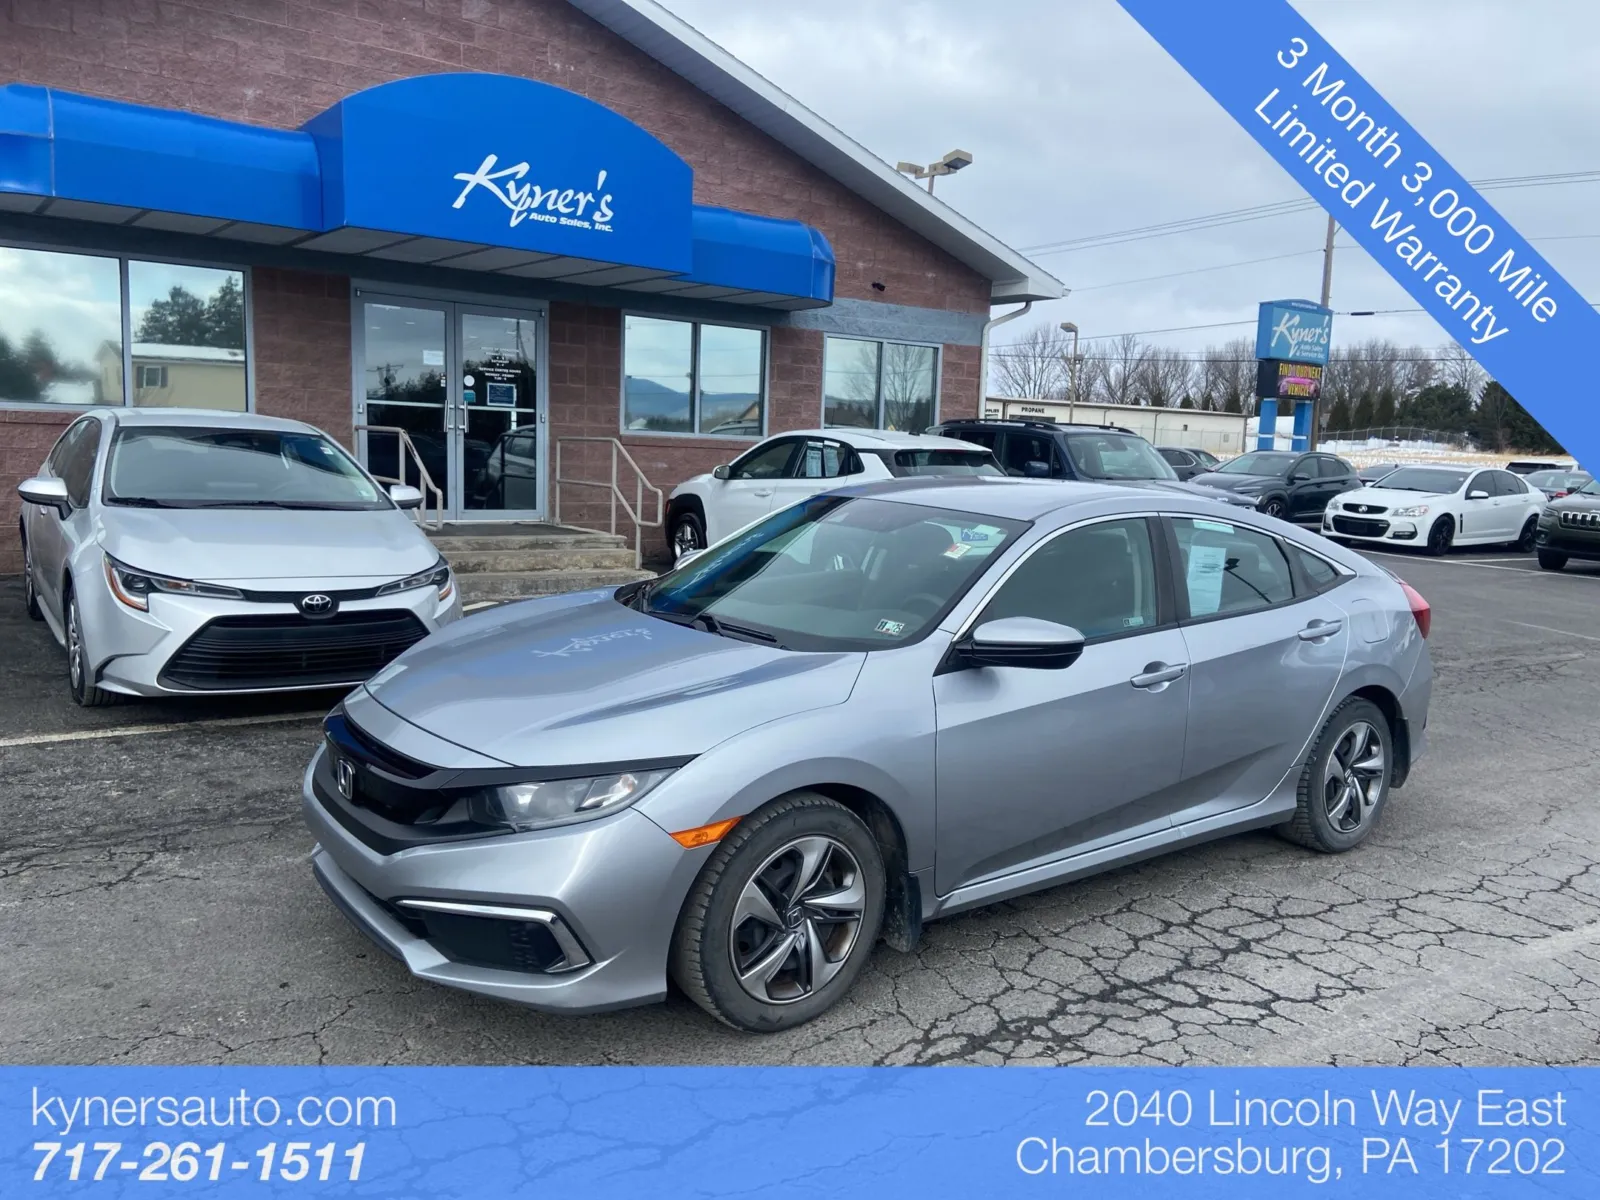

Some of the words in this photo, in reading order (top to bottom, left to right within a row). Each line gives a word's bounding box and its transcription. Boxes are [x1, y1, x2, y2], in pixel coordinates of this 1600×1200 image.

[452, 154, 614, 228] Kyner's
[528, 212, 558, 224] Auto
[559, 216, 592, 230] Sales,
[594, 222, 614, 233] Inc.
[1271, 312, 1329, 358] Kyner's
